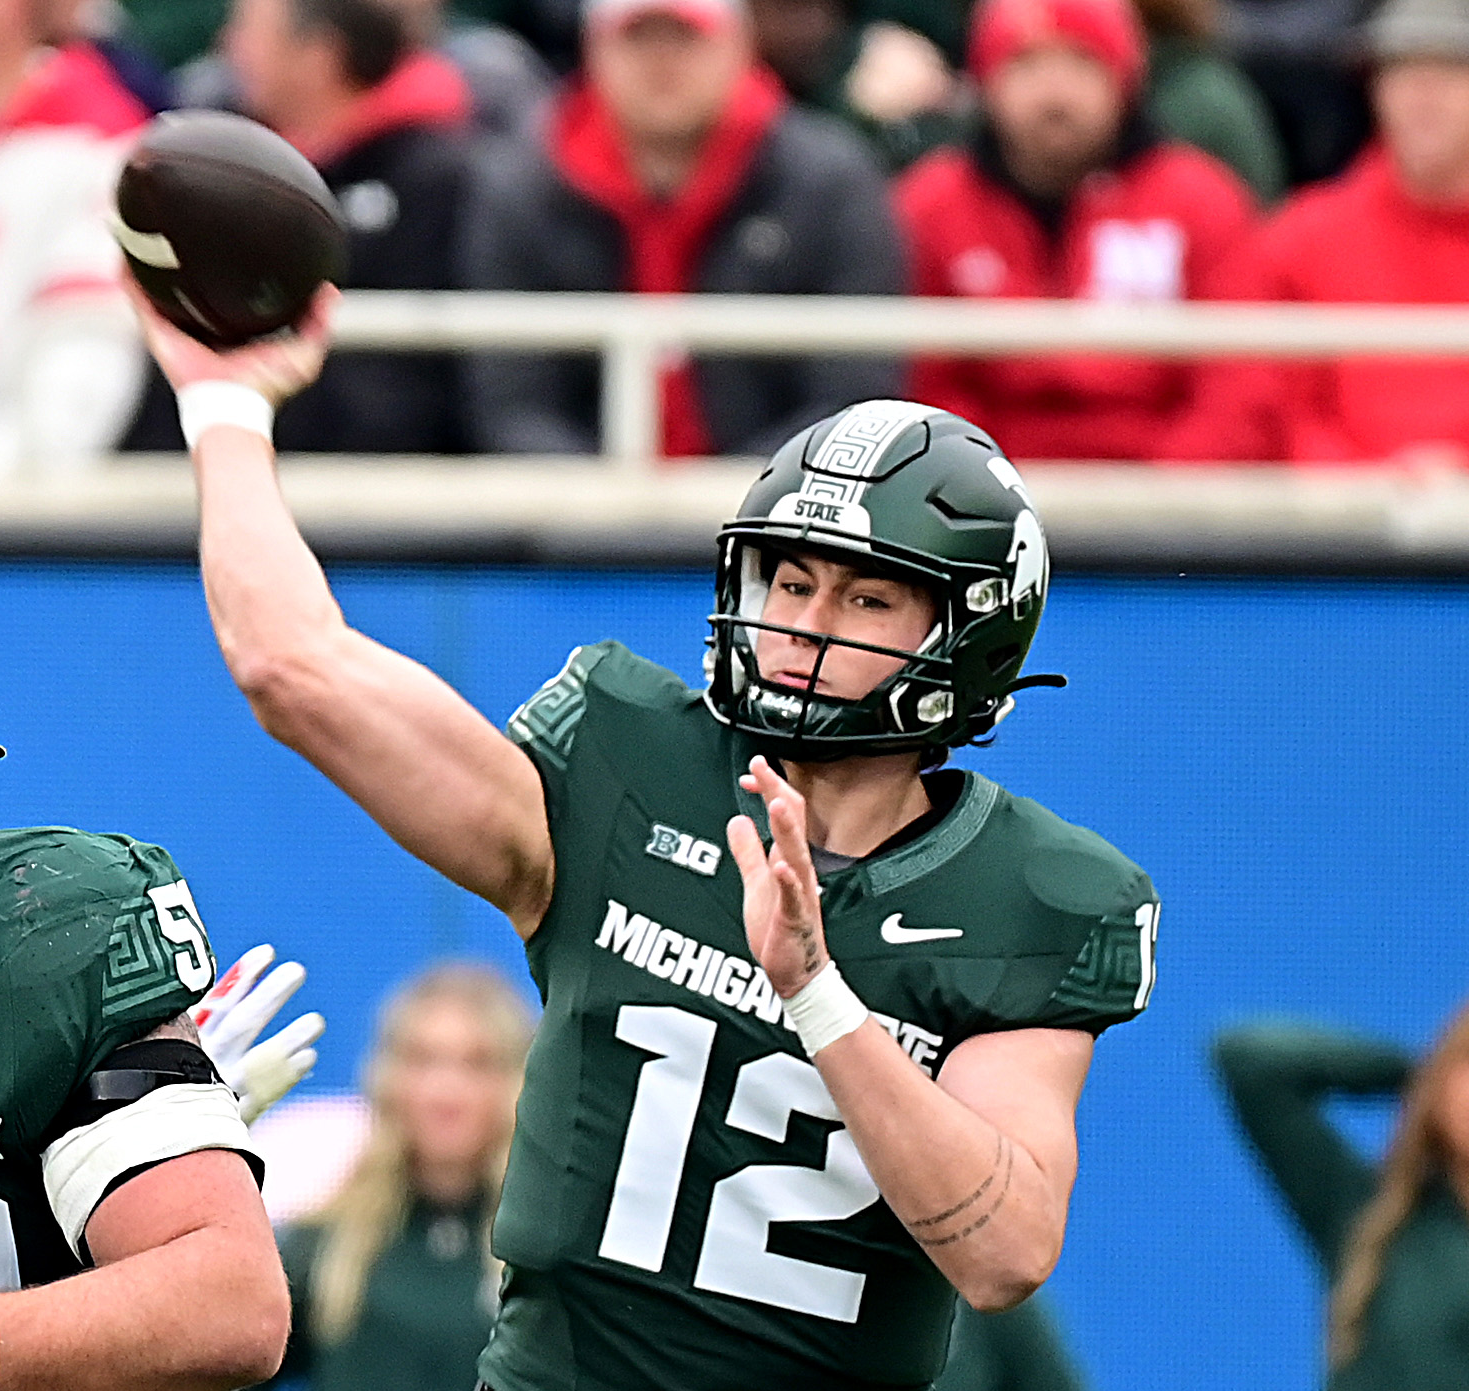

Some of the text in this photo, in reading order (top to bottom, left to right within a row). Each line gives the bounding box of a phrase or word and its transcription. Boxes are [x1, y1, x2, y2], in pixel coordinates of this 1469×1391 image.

[794, 499, 844, 524] STATE
[147, 879, 216, 992] 5
[595, 899, 797, 1032] MICHIGA
[1134, 902, 1161, 1009] 1
[598, 1005, 880, 1323] 12
